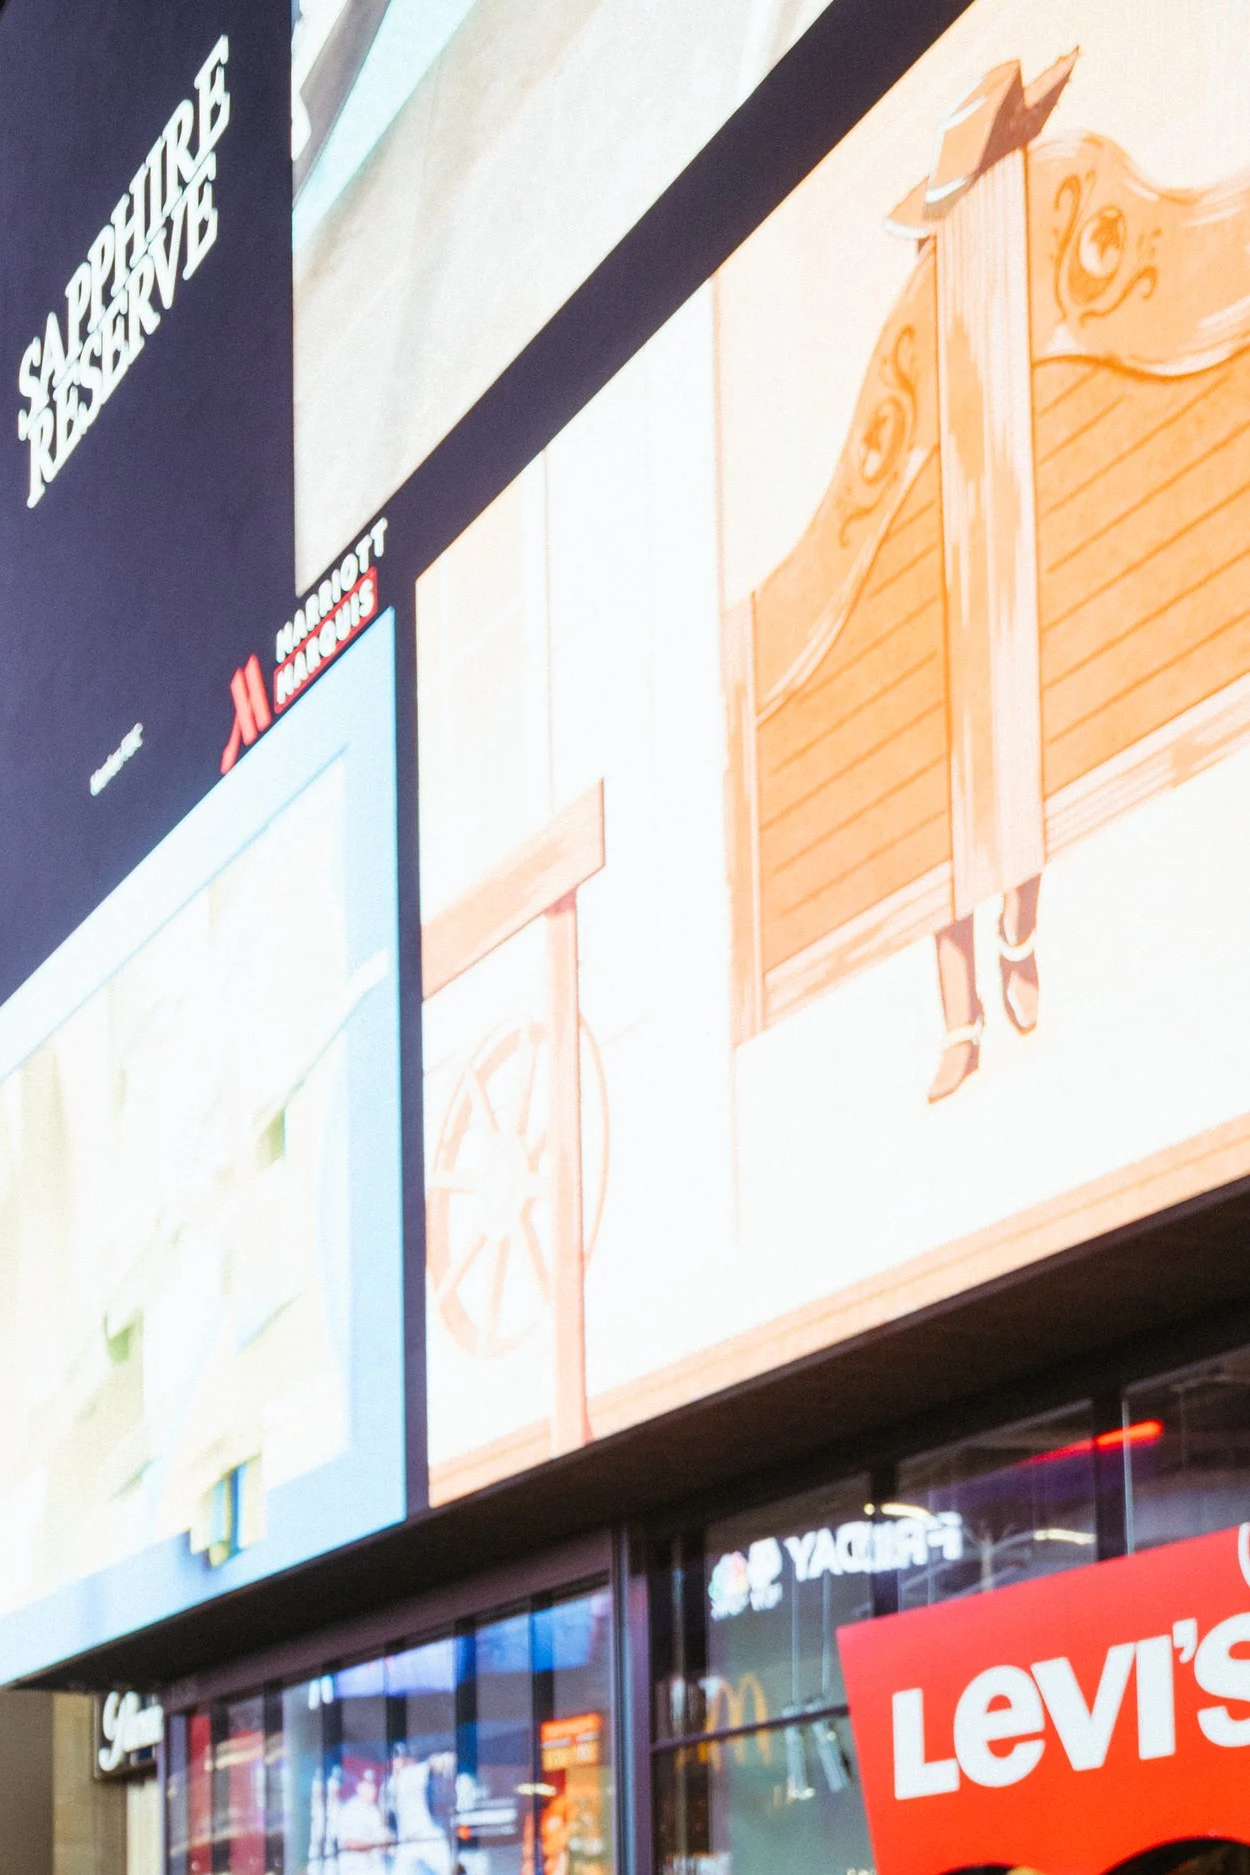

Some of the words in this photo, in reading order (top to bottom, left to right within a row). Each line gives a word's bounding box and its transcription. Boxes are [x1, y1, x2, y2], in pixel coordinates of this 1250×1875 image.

[18, 34, 230, 441] SAPPHIRE
[27, 151, 218, 509] RESERVE
[275, 516, 389, 663] MARRIOTT
[275, 578, 375, 705] MARQUIS
